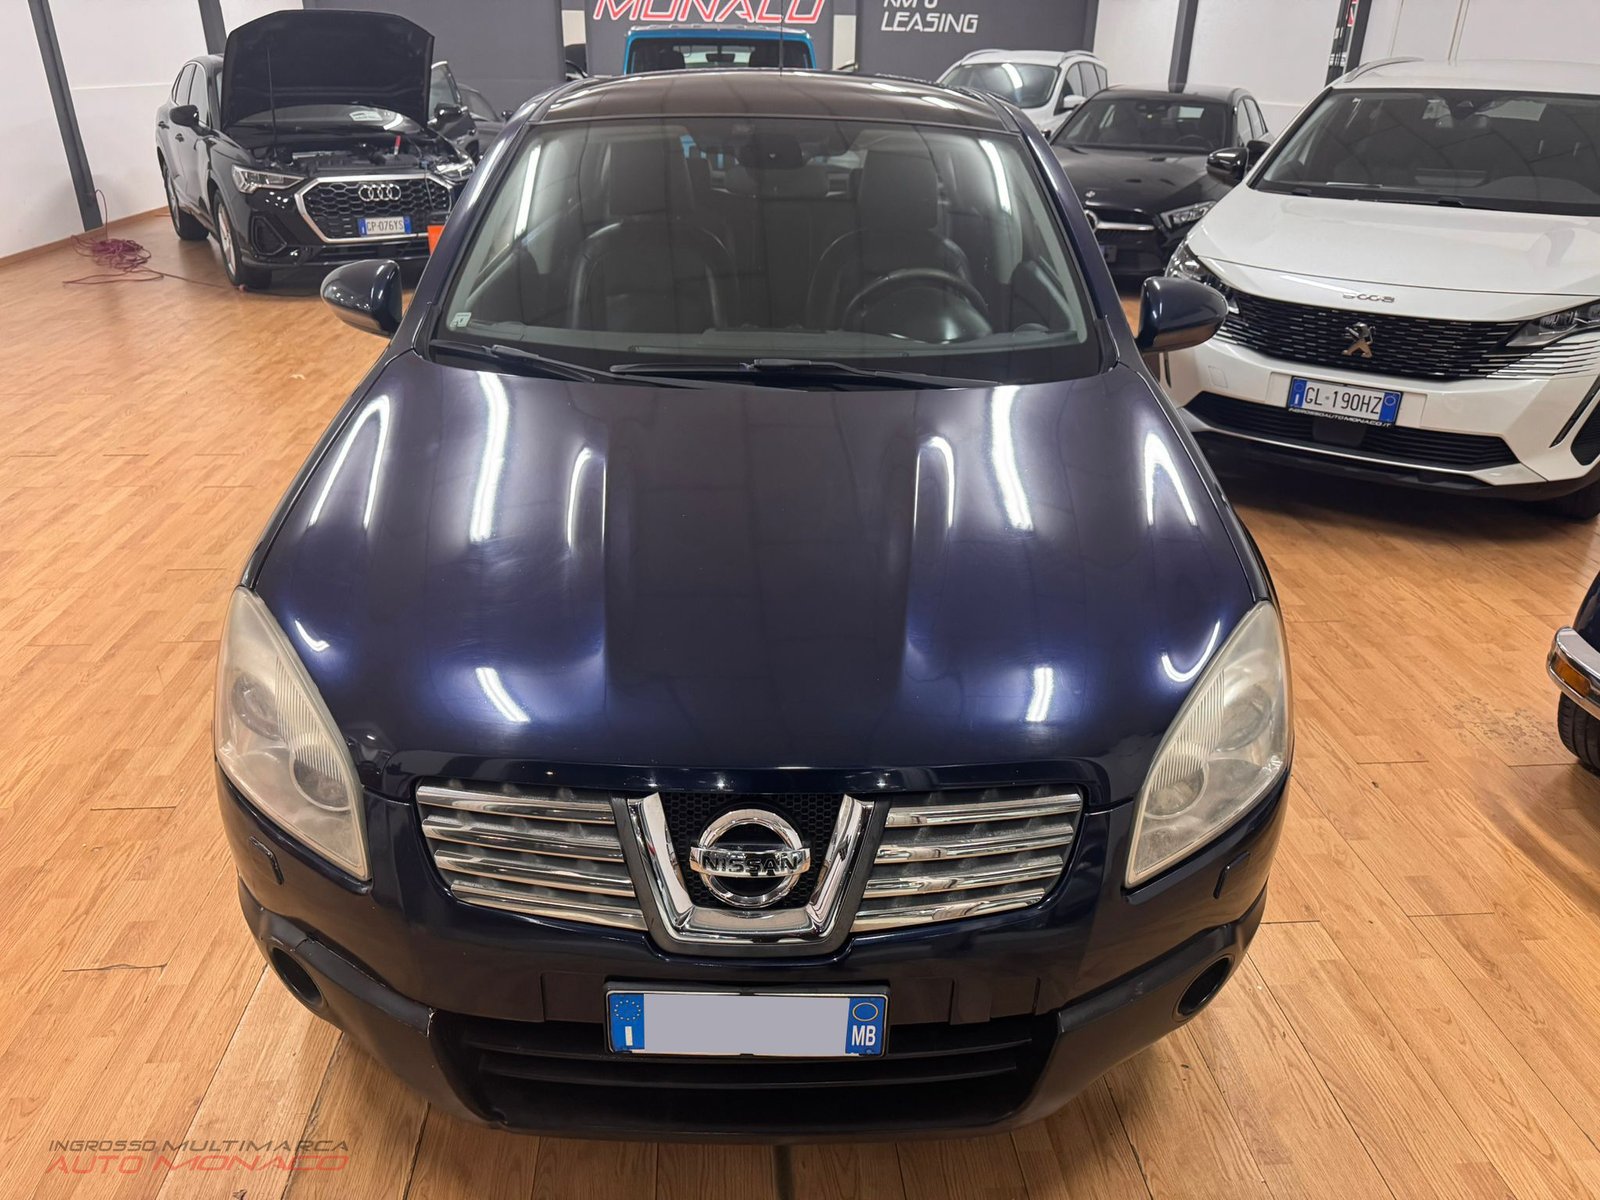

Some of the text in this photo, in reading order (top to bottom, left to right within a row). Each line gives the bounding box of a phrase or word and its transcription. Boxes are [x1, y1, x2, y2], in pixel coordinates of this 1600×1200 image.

[881, 11, 979, 33] LEASING
[702, 855, 799, 874] NISSAN
[850, 1024, 877, 1047] MB
